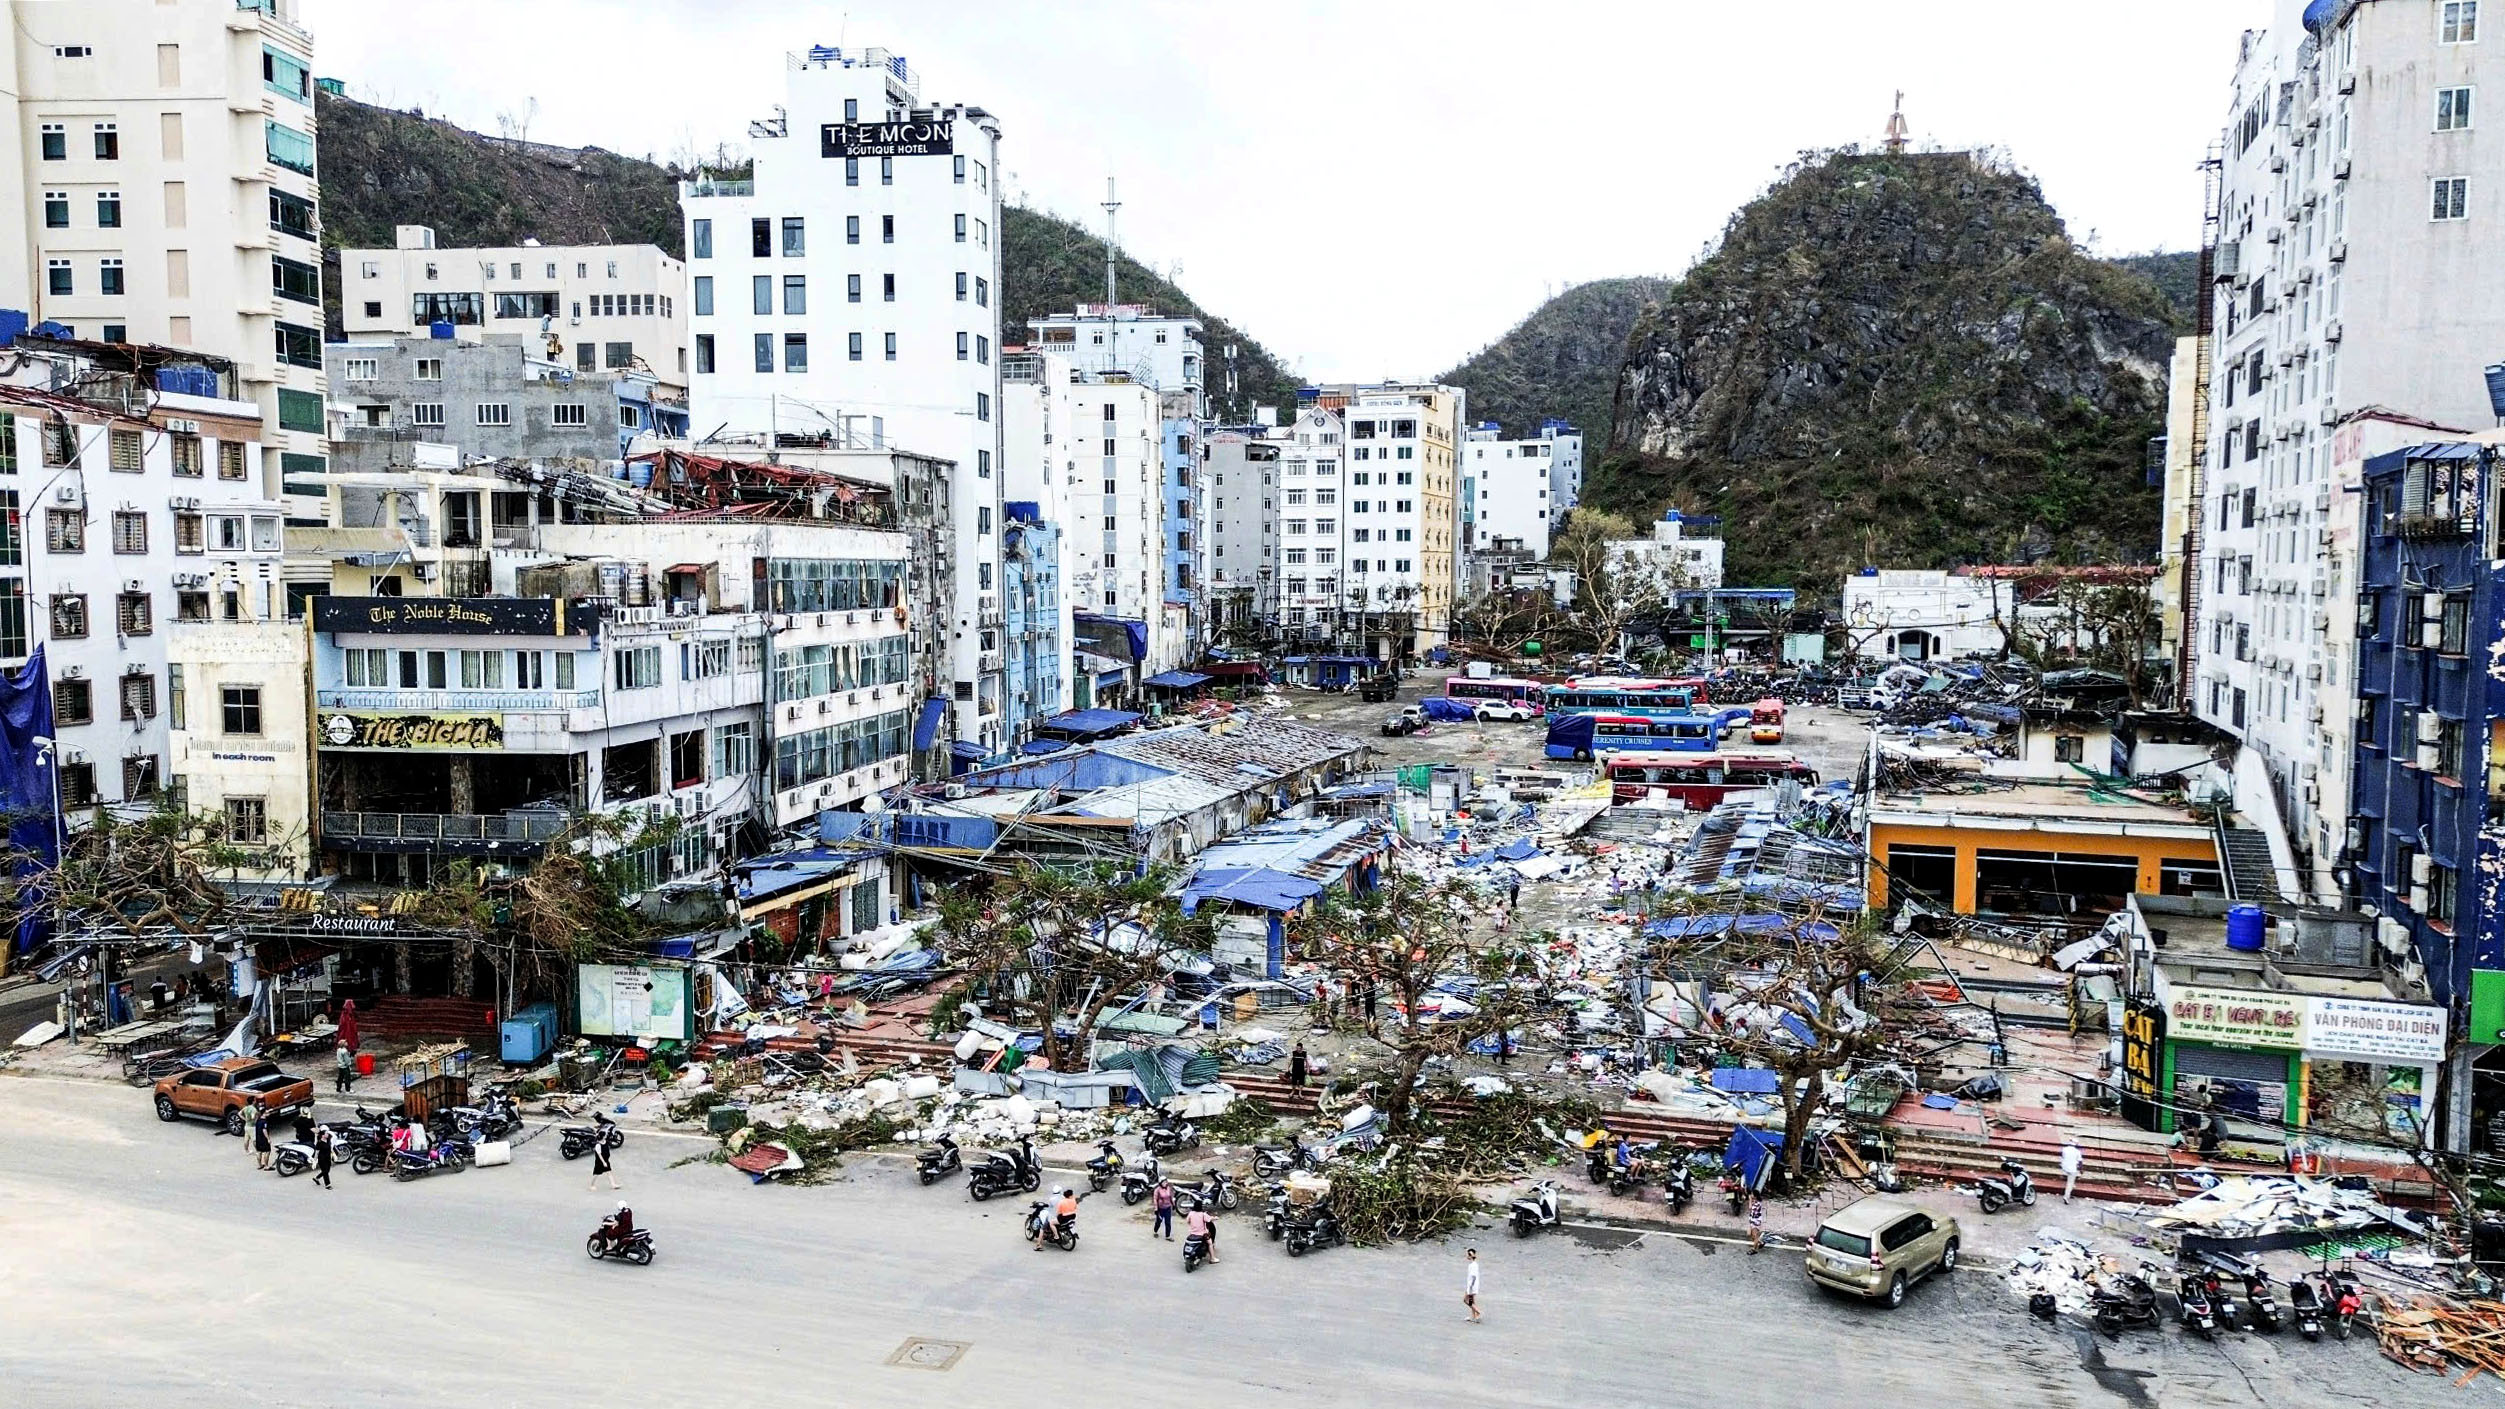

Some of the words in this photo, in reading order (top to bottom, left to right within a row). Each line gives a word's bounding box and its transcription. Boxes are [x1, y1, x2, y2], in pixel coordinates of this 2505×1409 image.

[880, 124, 950, 142] MOON
[847, 145, 895, 155] BOUTIQUE
[898, 144, 928, 154] HOTEL
[369, 606, 396, 623] The
[403, 603, 444, 623] Noble
[447, 604, 493, 625] House
[363, 719, 402, 744] THE
[1591, 737, 1624, 745] SERENITY
[1625, 737, 1653, 746] CRUISES
[248, 754, 275, 762] room
[312, 914, 397, 931] Restaurant
[2174, 1001, 2200, 1020] CAT
